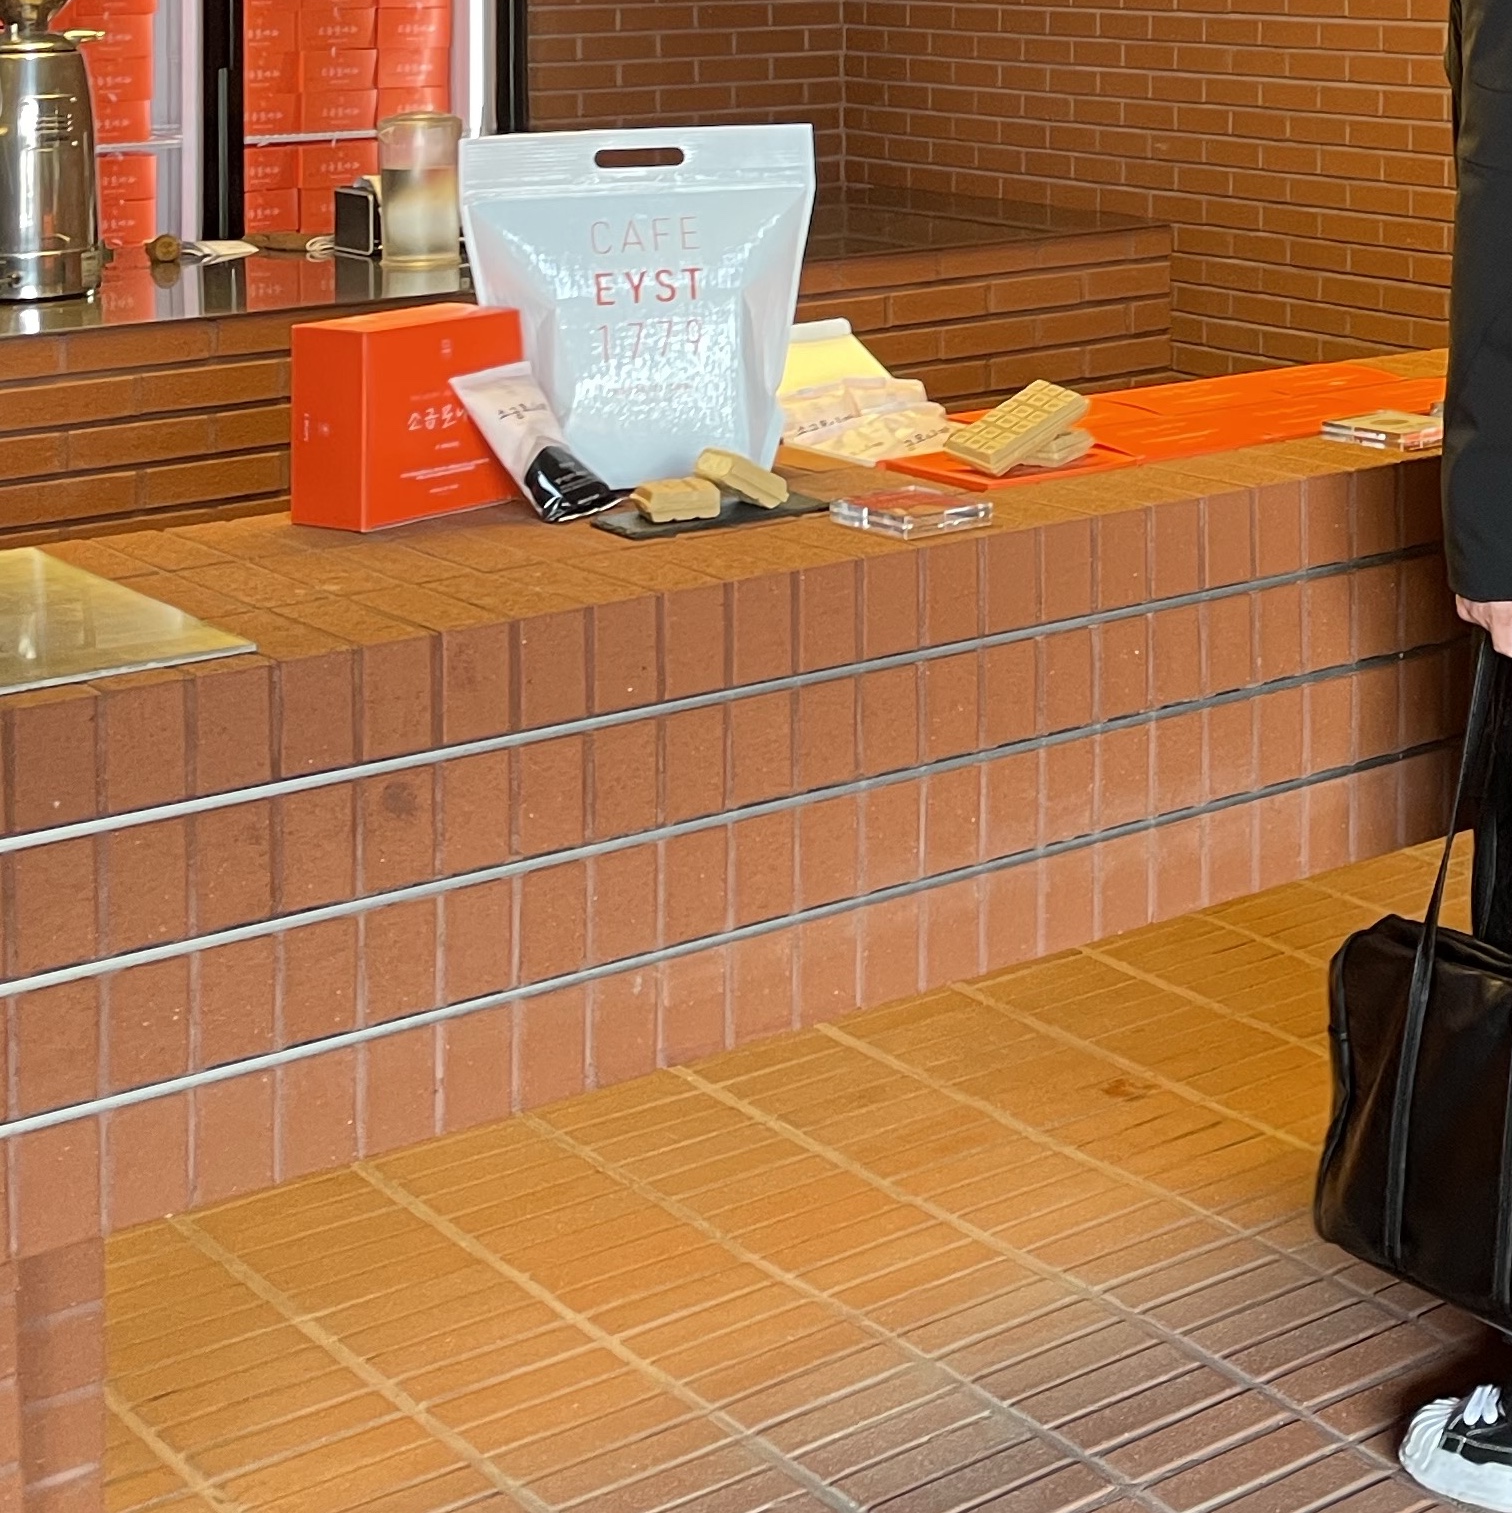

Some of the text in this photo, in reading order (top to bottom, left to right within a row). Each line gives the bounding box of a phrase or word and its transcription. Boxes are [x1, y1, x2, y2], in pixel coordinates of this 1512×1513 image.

[591, 216, 701, 255] CAFE
[594, 267, 703, 306] EYST
[597, 318, 703, 364] 1779
